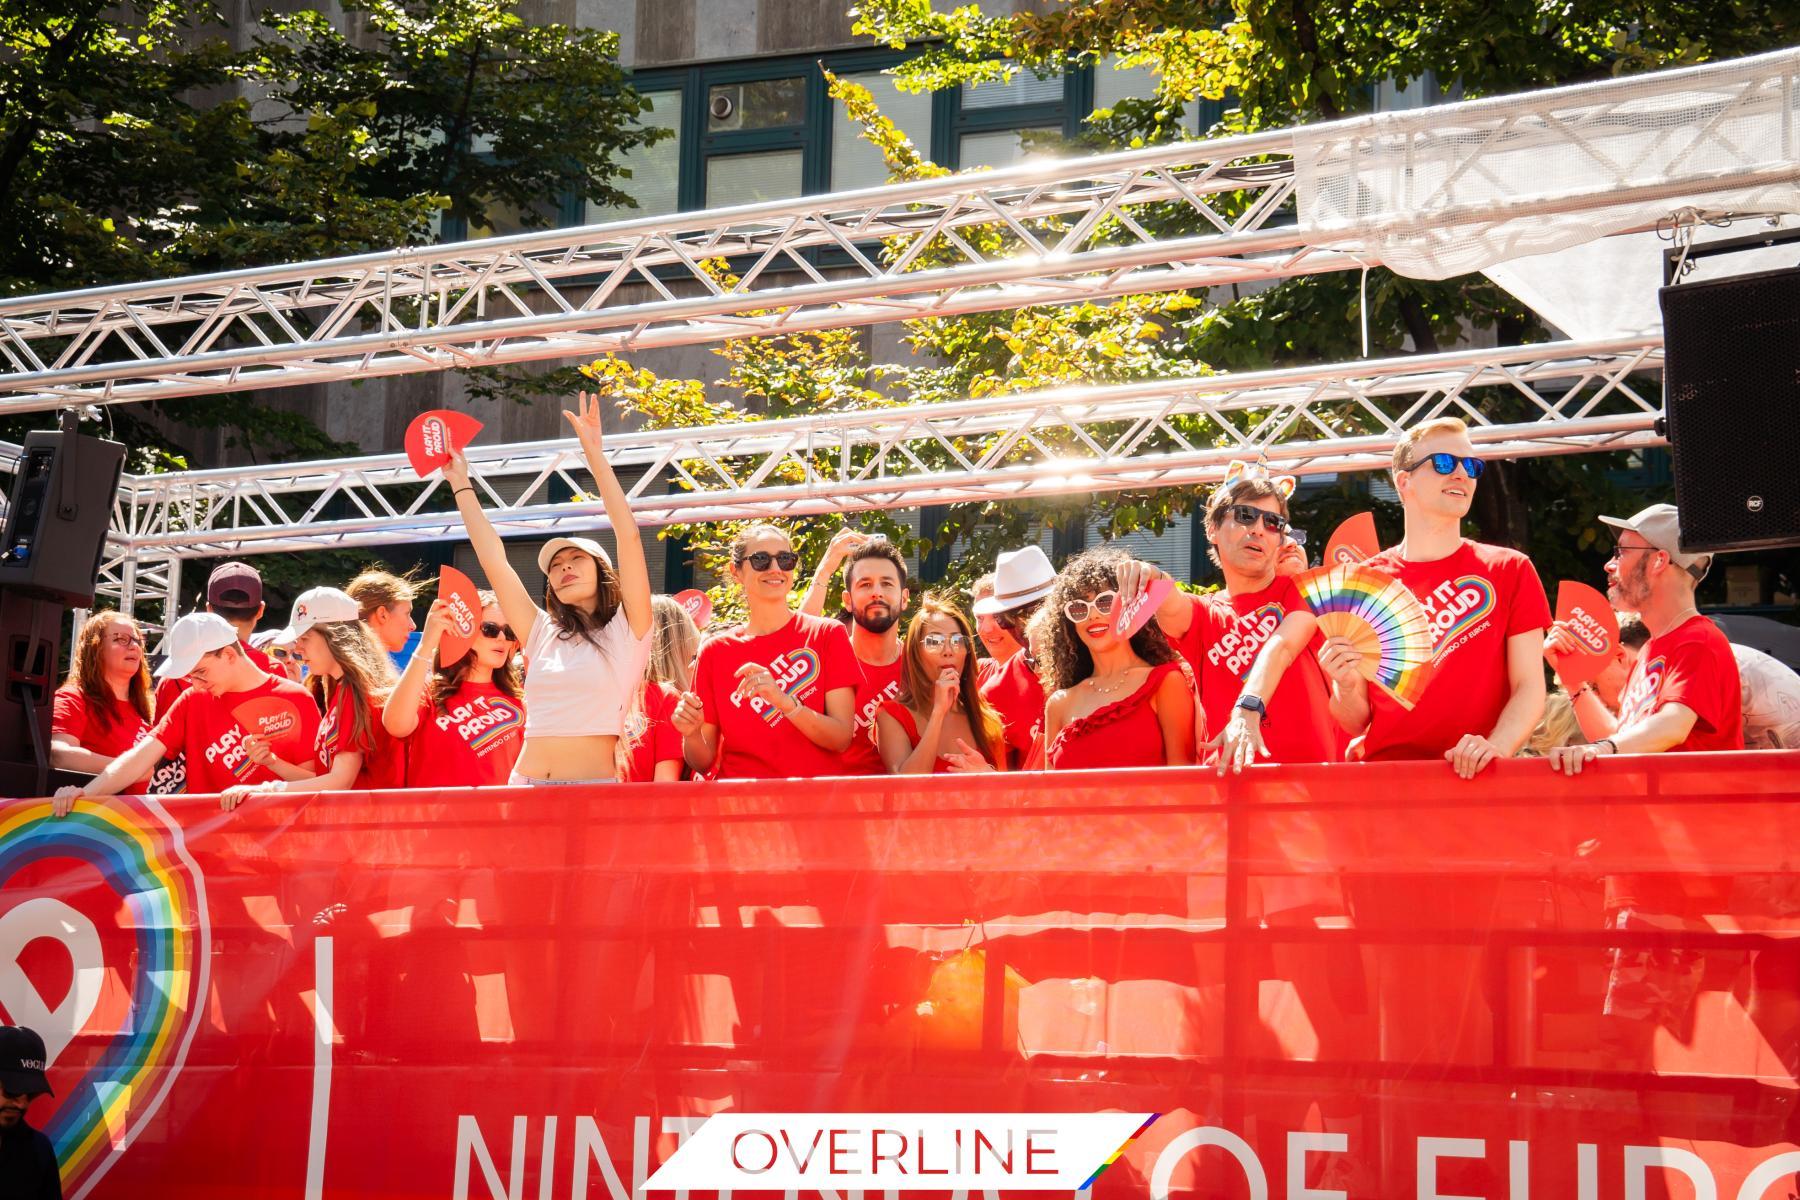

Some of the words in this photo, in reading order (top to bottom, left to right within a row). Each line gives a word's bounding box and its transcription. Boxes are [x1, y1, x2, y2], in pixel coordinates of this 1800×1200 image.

[422, 424, 431, 434] IT
[431, 420, 443, 454] PROUD
[423, 434, 434, 457] PLAY
[450, 592, 468, 613] PLAY
[465, 611, 474, 621] IT
[1433, 579, 1456, 604] IT
[1428, 588, 1480, 643] ROUD
[1570, 606, 1599, 629] PLAY
[1594, 625, 1608, 637] IT
[1207, 620, 1242, 667] PLAY
[1240, 611, 1258, 630] IT
[1226, 615, 1277, 676] PROUD
[1433, 642, 1460, 668] NINTENDO
[1459, 635, 1469, 644] OF
[1468, 620, 1491, 638] EUROPE
[1567, 618, 1603, 649] PROUD
[769, 653, 789, 675] IT
[750, 659, 808, 714] POUD
[259, 713, 280, 726] PLAY
[279, 711, 289, 720] IT
[435, 703, 476, 732] PLAY
[458, 708, 512, 741] PROUD
[853, 693, 884, 738] LAY
[883, 680, 899, 700] IT
[263, 718, 292, 734] PROUD
[205, 723, 242, 764] PLAY
[223, 734, 253, 770] PRO
[477, 738, 503, 758] NINTENDO
[157, 765, 186, 794] PRO
